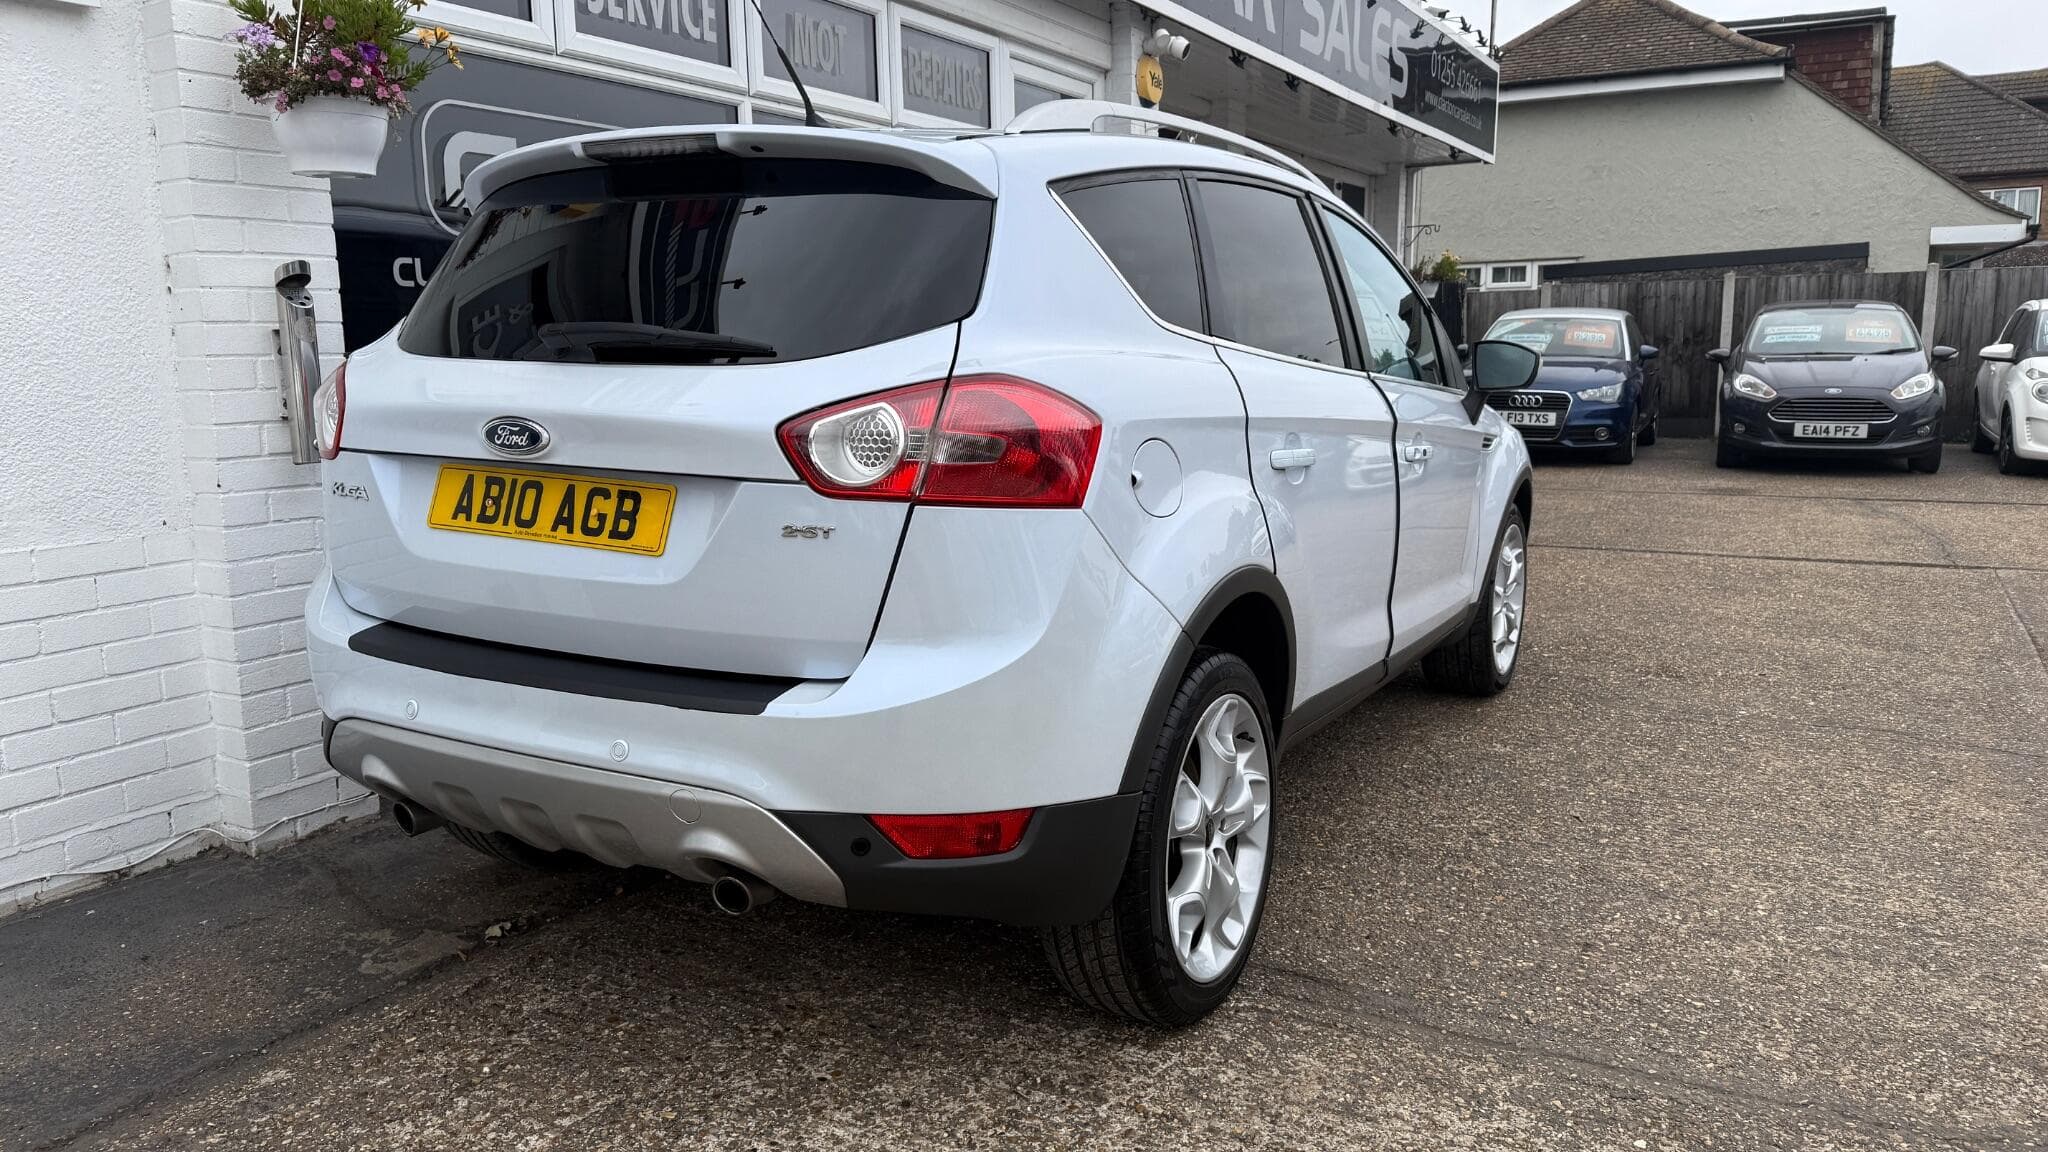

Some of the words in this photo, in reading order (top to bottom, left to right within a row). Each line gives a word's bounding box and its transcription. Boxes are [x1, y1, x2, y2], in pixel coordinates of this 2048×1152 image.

[587, 0, 719, 44] VICE
[789, 12, 848, 75] MOT
[1300, 0, 1411, 99] SALES
[905, 46, 984, 111] REPAIRS
[1149, 70, 1162, 90] Yale
[1430, 50, 1456, 89] 01255
[1456, 67, 1482, 105] 426661
[494, 424, 529, 446] Ford
[1501, 412, 1525, 424] F13
[1528, 413, 1550, 424] TXS
[1802, 424, 1830, 437] EA14
[1834, 425, 1860, 437] PFZ
[333, 481, 370, 501] KUGA
[451, 473, 544, 530] AB10
[550, 483, 642, 541] AGB
